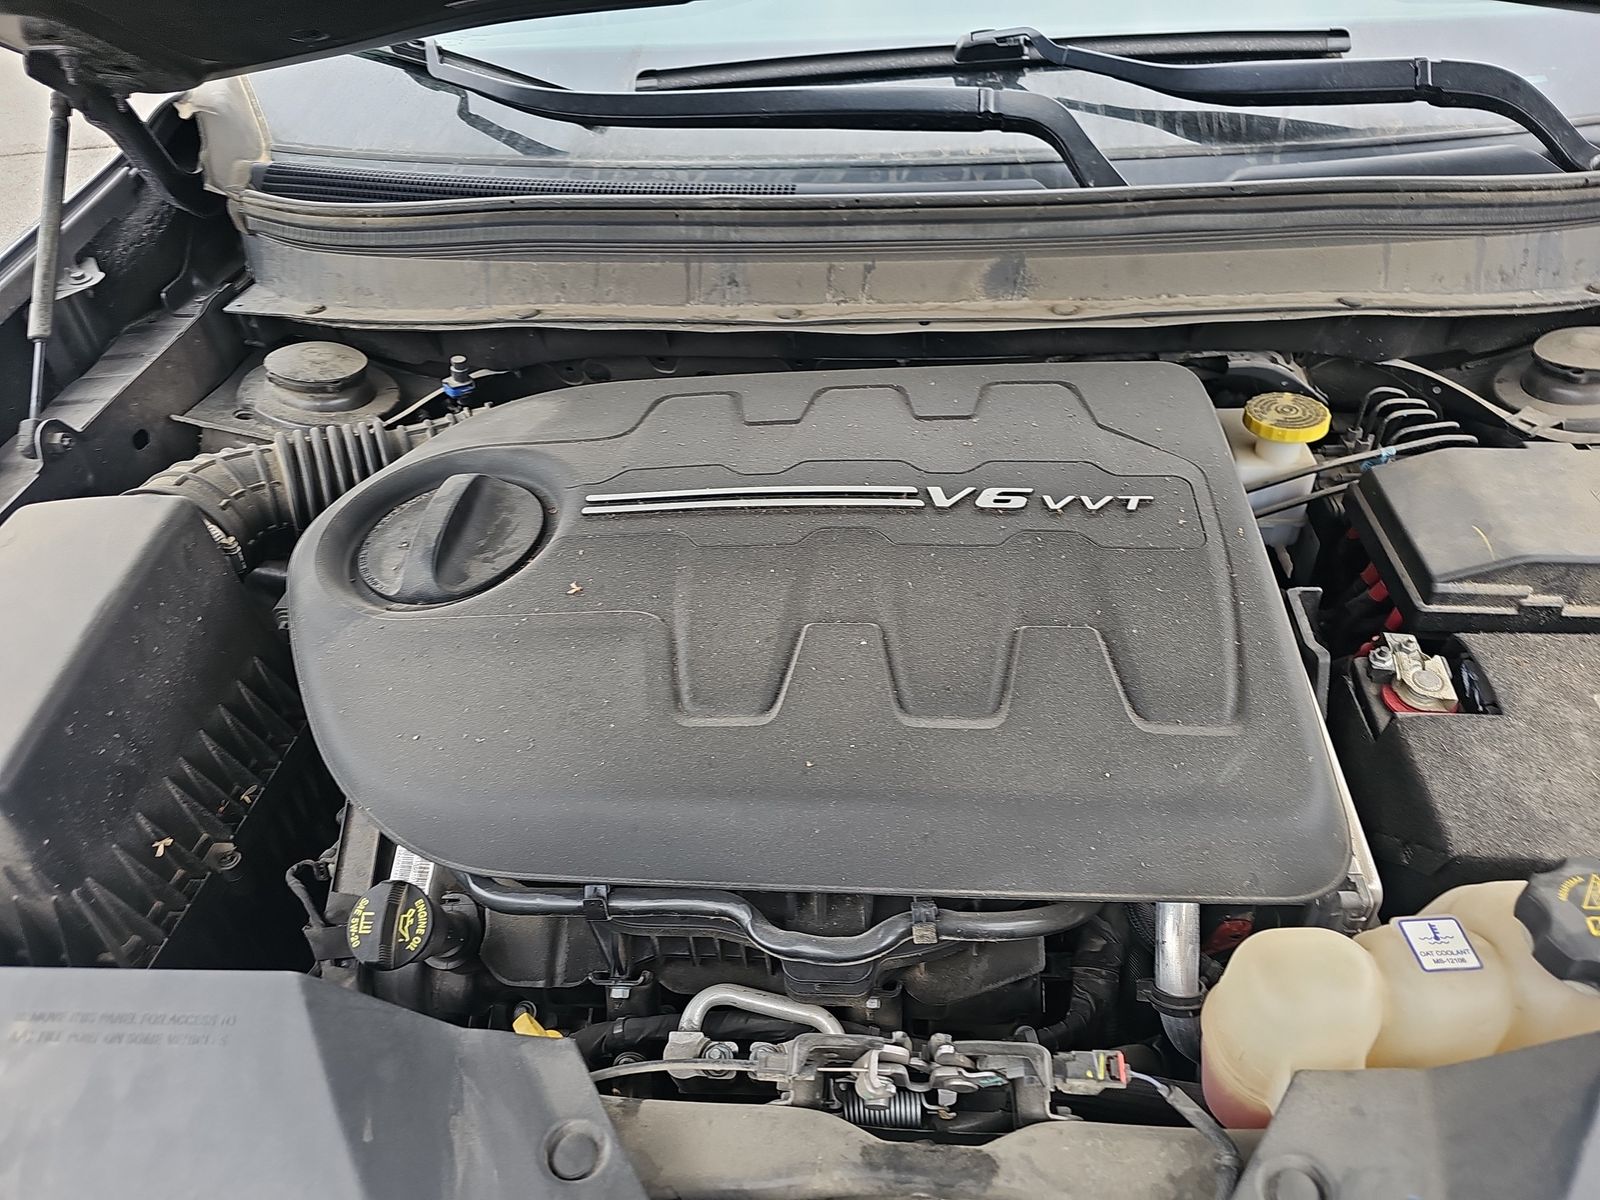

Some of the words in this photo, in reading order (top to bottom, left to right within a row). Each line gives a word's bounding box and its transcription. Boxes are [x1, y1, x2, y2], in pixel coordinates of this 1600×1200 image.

[926, 486, 1034, 509] V6
[1041, 494, 1154, 511] VVT
[353, 897, 369, 917] SAE
[414, 898, 428, 936] ENGINE
[349, 917, 361, 949] 5W-20
[405, 936, 421, 951] OIL
[1436, 948, 1471, 957] COOLANT
